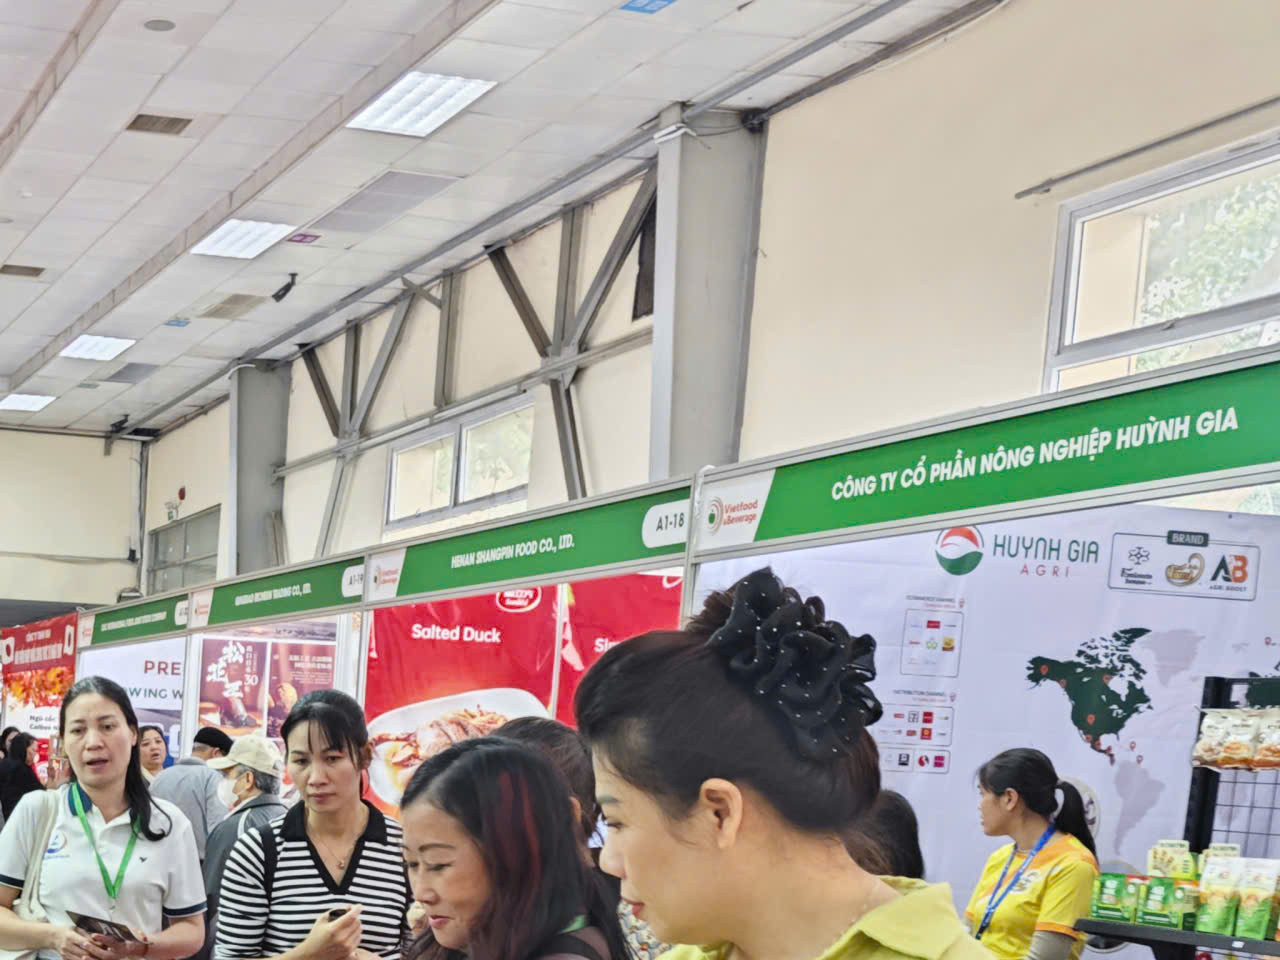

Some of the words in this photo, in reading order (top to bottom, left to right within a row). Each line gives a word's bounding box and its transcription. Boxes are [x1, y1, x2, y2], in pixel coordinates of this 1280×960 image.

[831, 473, 877, 501] CÔNG
[880, 471, 898, 494] TY
[900, 455, 927, 488] CỔ
[929, 448, 976, 483] PHẦN
[980, 445, 1036, 475] NÔNG
[1038, 427, 1113, 463] NGHIỆP
[1115, 415, 1191, 450] HUỲNH
[1195, 406, 1239, 436] GIA
[723, 500, 759, 516] Vietfood
[656, 511, 685, 532] A1-18
[992, 533, 1062, 562] HUYNH
[1067, 538, 1100, 564] GIA
[1171, 532, 1205, 546] BRAND
[451, 551, 475, 569] HENAN
[515, 541, 539, 558] FOOD
[1019, 564, 1071, 578] AGRI
[411, 623, 461, 640] Salted
[463, 626, 501, 643] Duck
